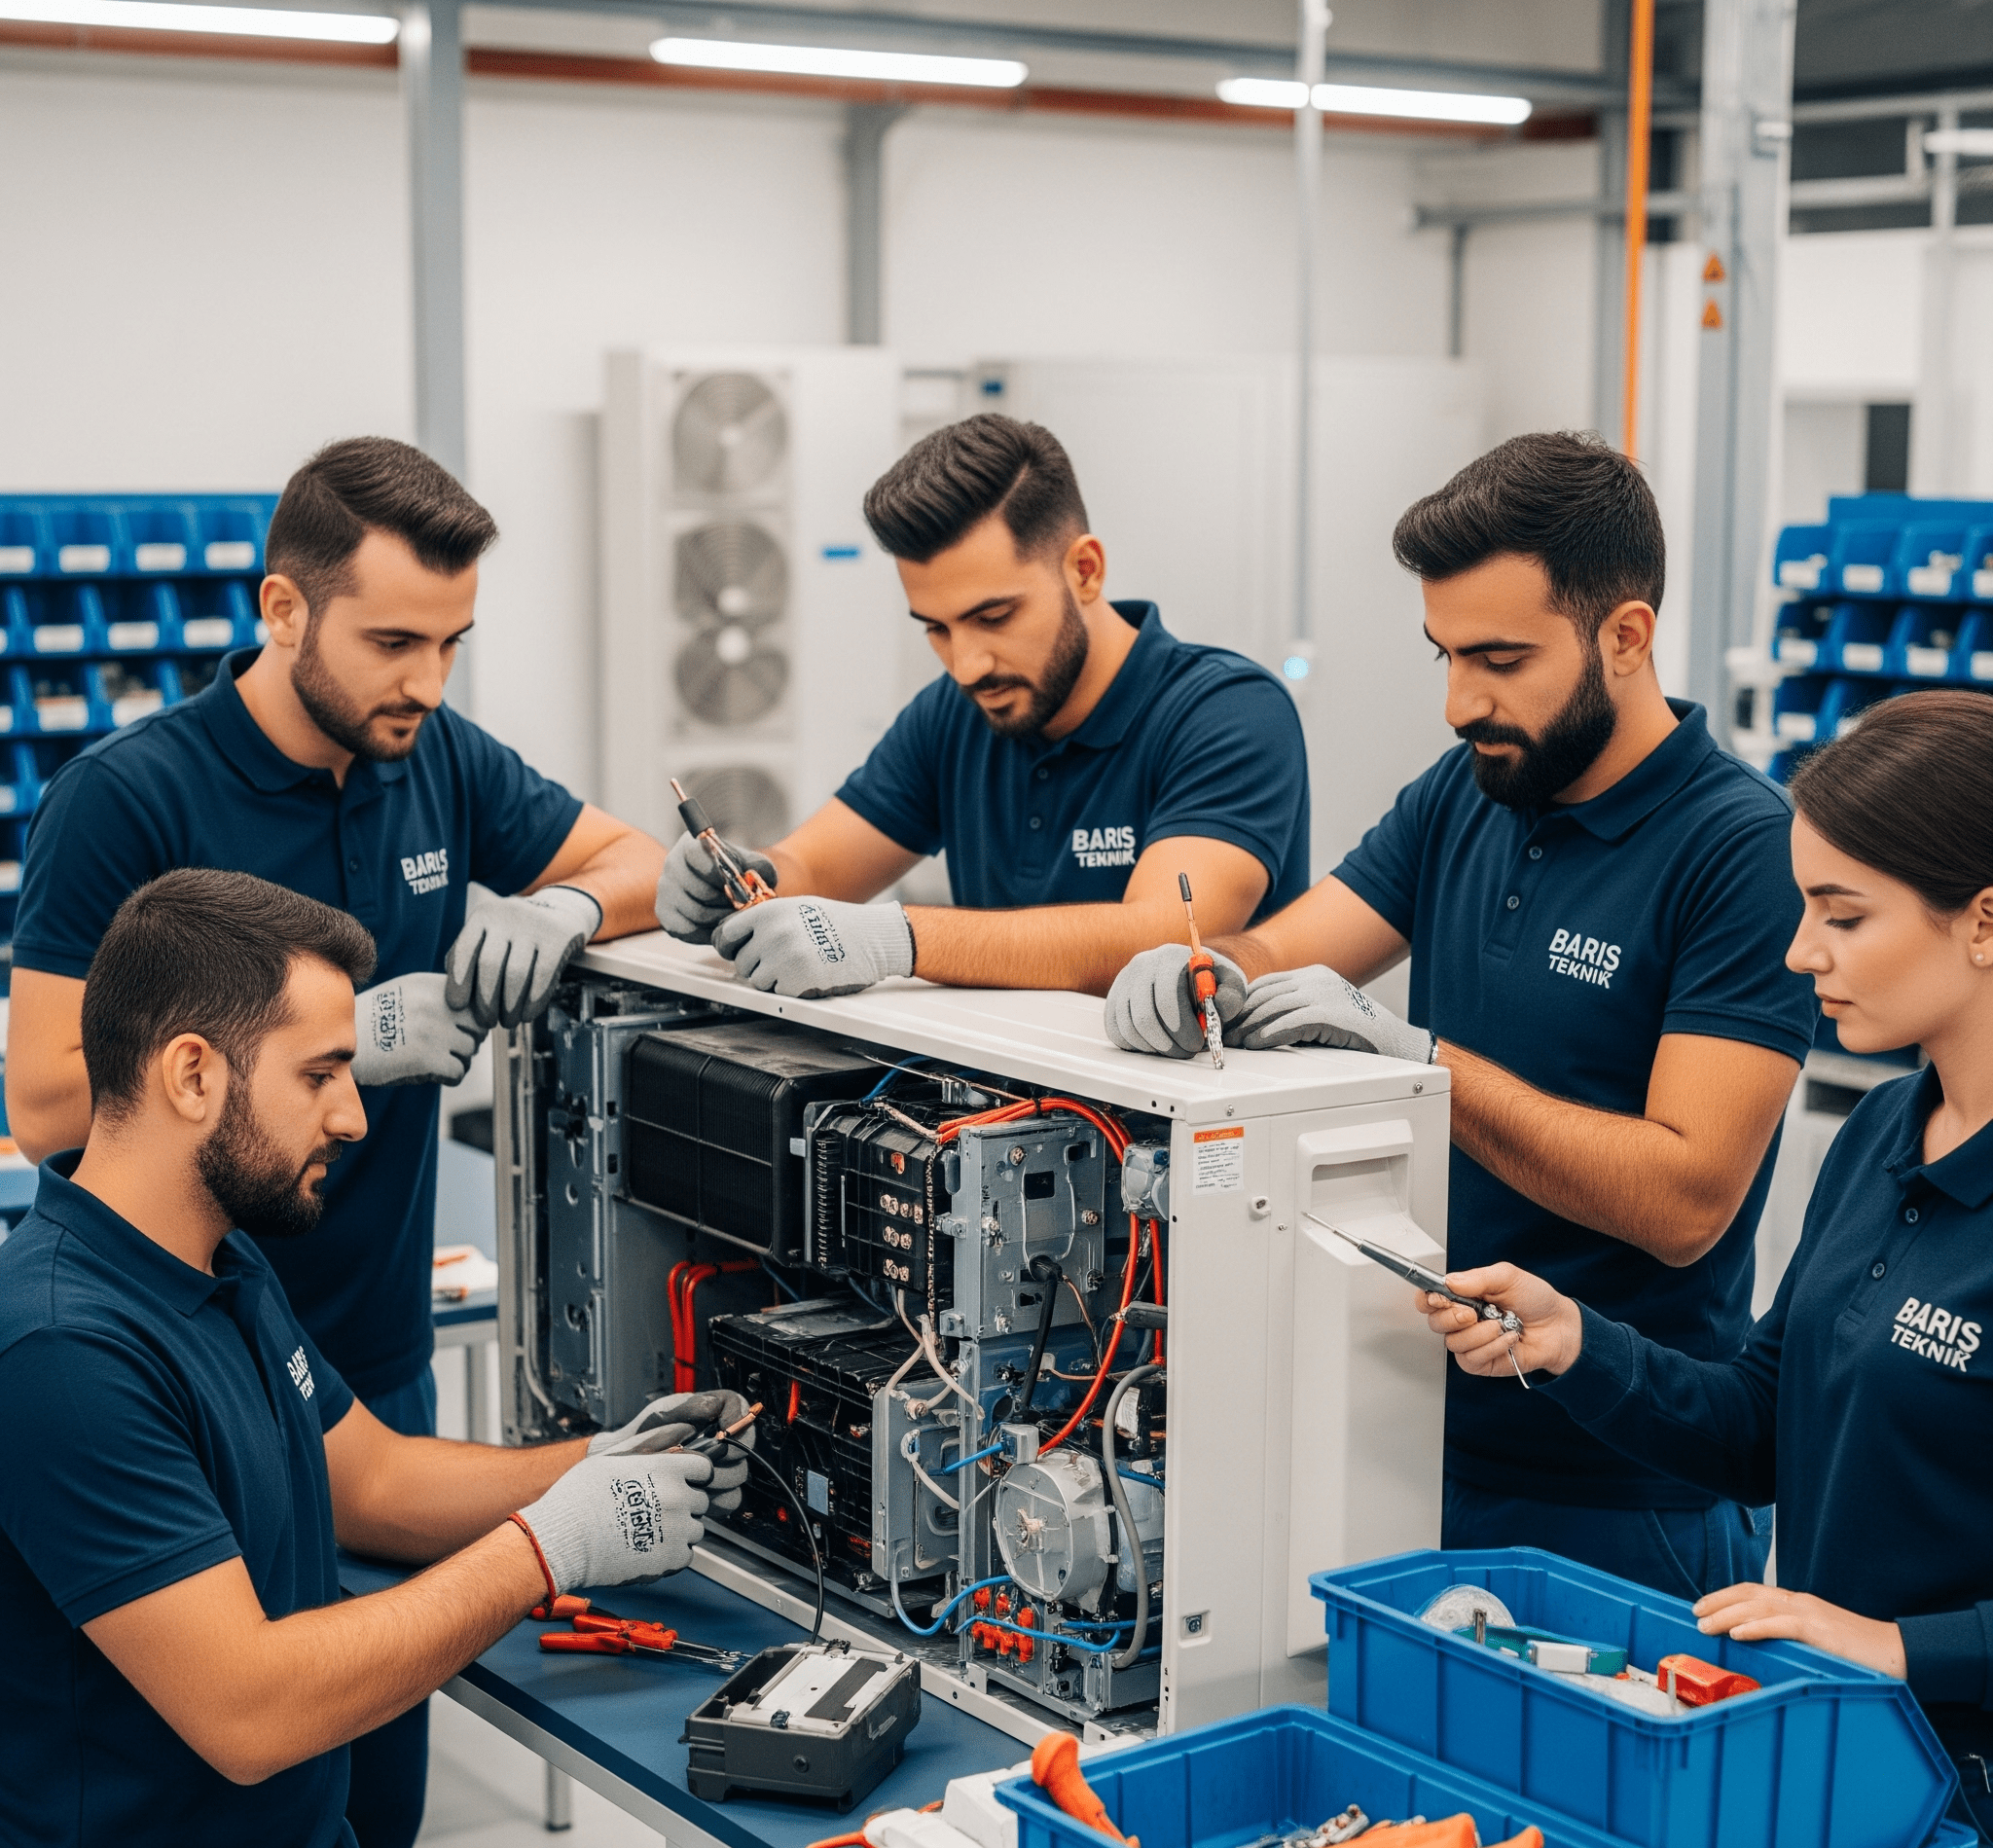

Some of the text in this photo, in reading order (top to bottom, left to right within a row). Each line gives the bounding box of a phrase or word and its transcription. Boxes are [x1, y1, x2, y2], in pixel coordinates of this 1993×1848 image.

[1071, 825, 1136, 852] BARIS
[400, 848, 449, 881] BARIS
[1548, 927, 1621, 971] BARIS
[1548, 954, 1613, 989] TEKNIK
[1894, 1296, 1982, 1353] BARIS
[1891, 1324, 1972, 1372] TEKNIK
